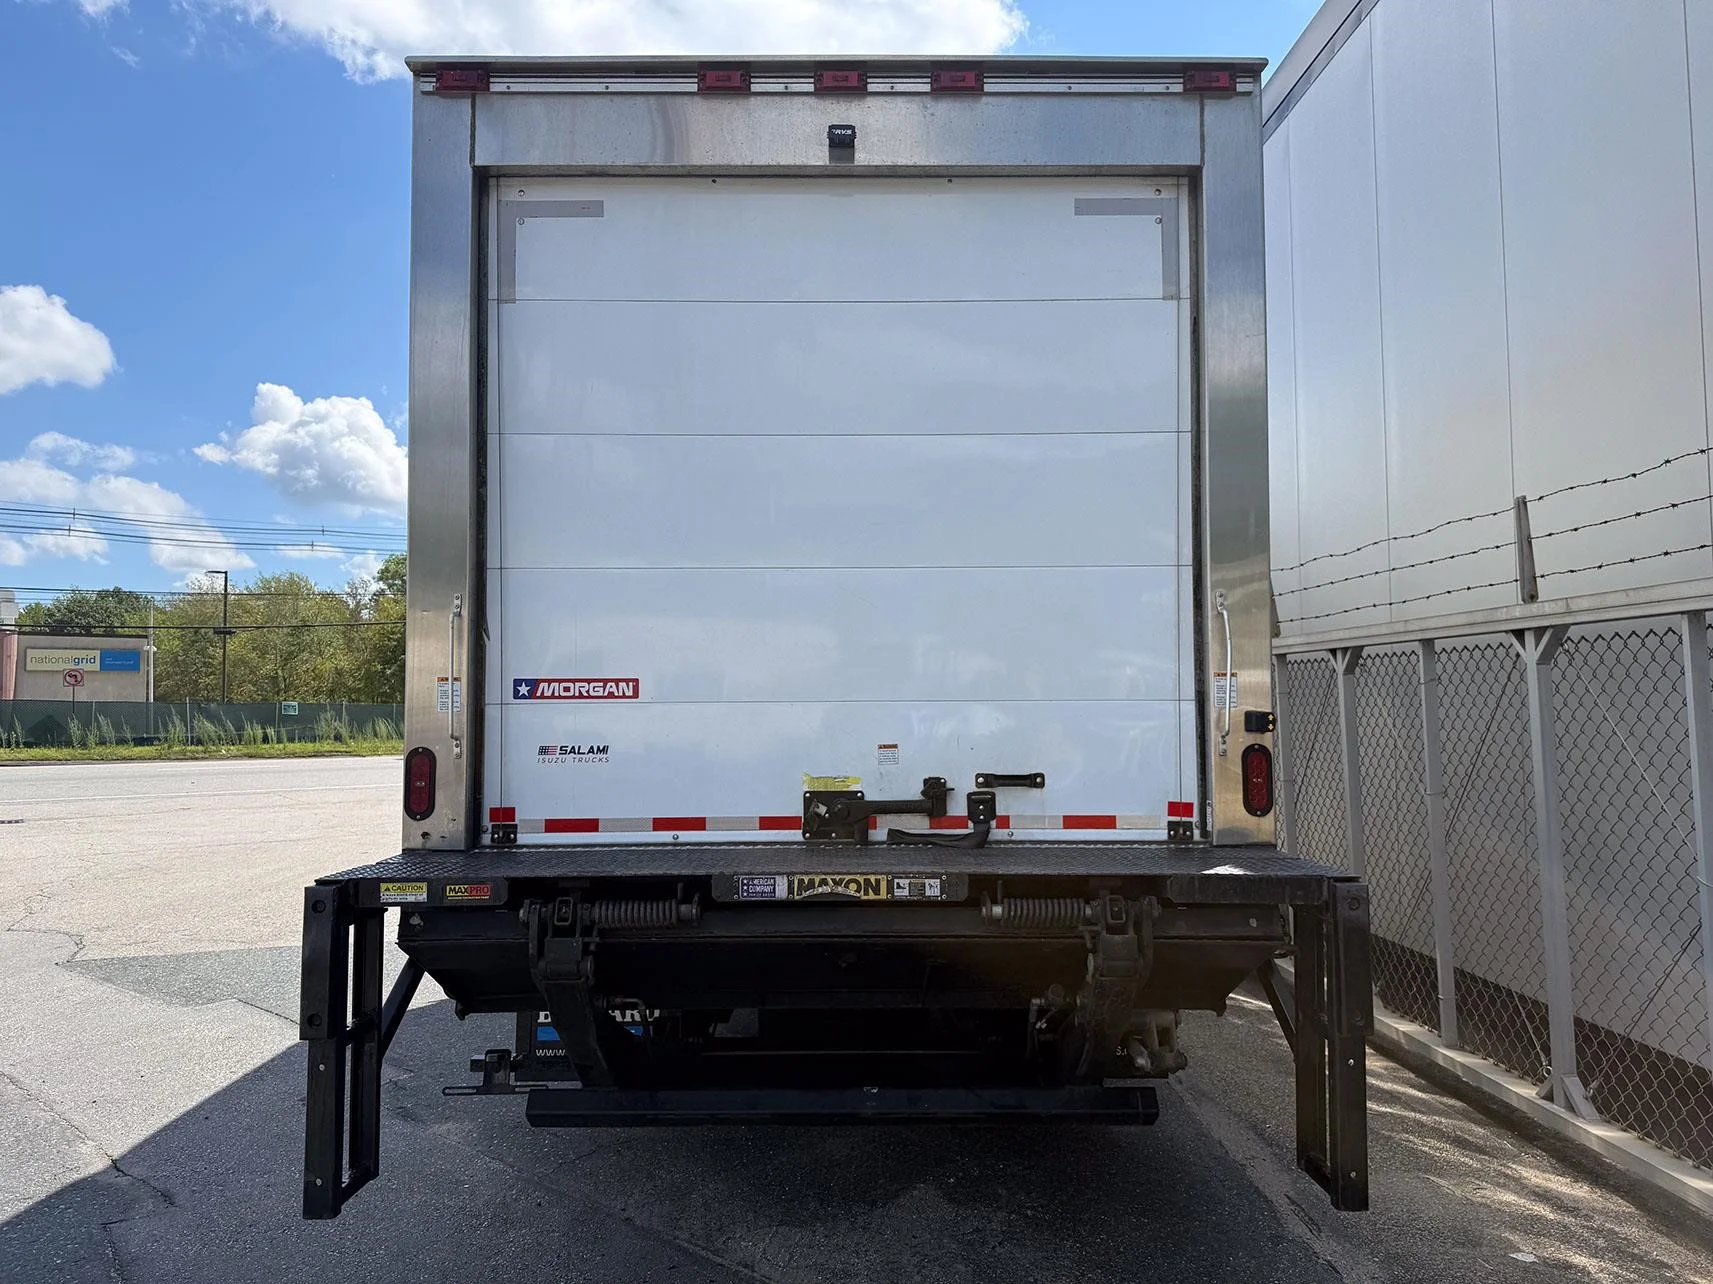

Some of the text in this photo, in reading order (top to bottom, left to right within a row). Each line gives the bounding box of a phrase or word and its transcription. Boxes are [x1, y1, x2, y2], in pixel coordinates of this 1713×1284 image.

[30, 654, 96, 666] nationalgrid
[536, 682, 634, 696] MORGAN
[558, 745, 609, 755] SALAMI
[448, 886, 489, 895] MAXPRO
[749, 885, 775, 893] COMPANY
[797, 877, 882, 897] MAXON
